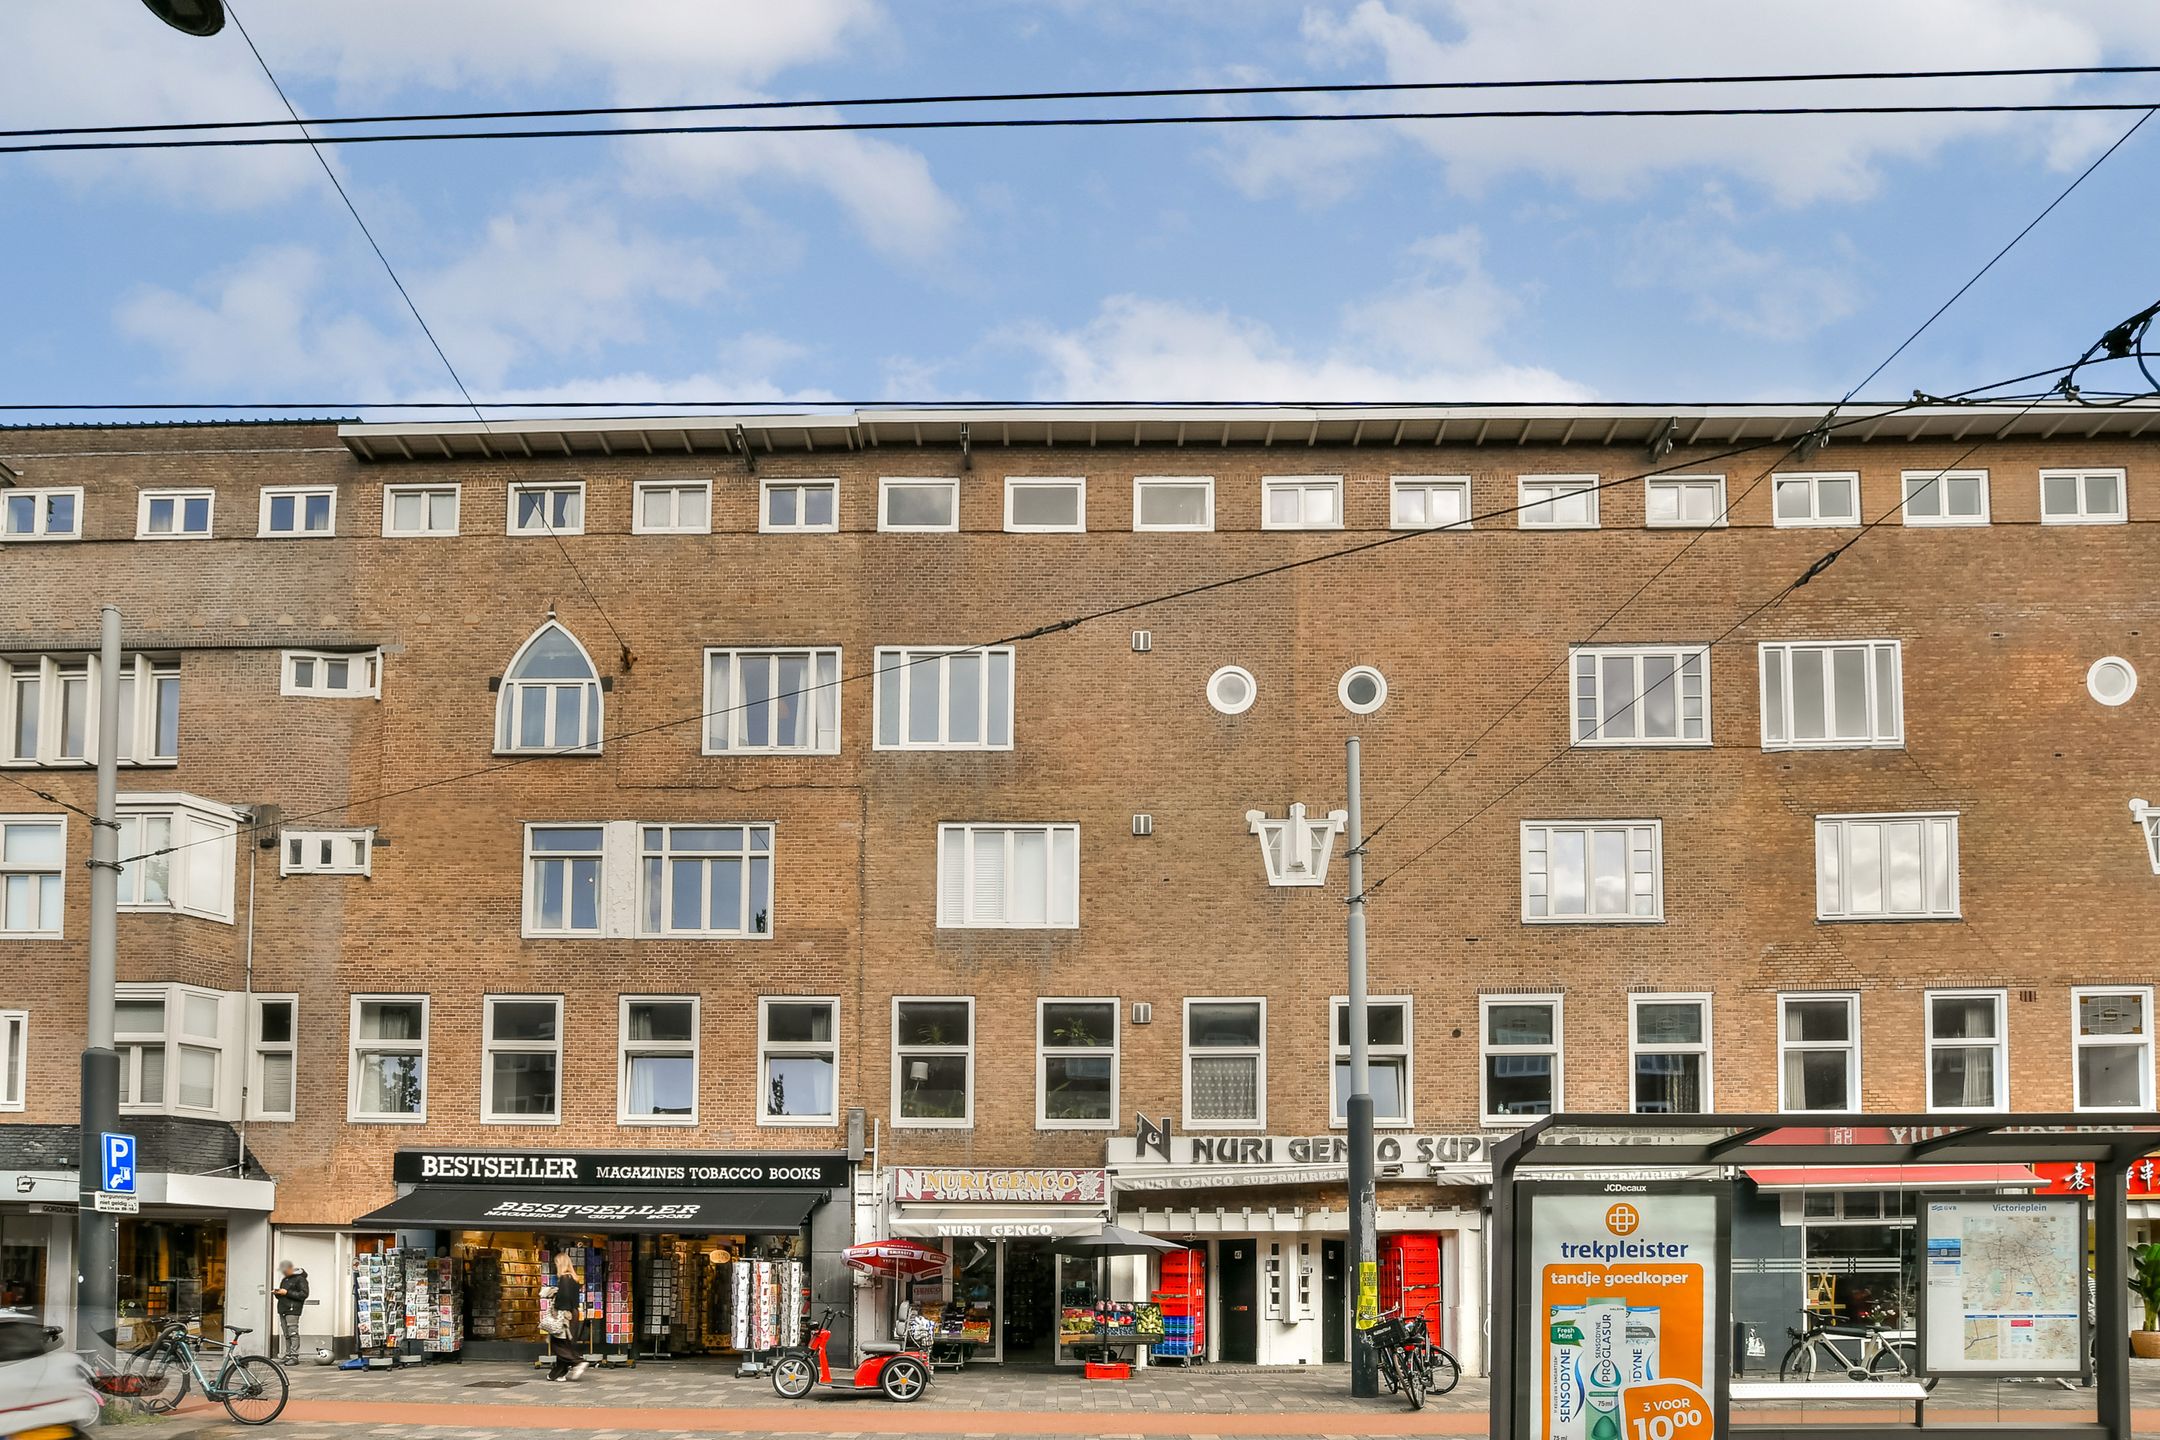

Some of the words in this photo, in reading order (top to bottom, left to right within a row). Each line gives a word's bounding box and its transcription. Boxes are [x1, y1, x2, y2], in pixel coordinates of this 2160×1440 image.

[1147, 1132, 1160, 1145] G
[110, 1138, 129, 1168] P
[1192, 1137, 1273, 1163] NURI
[1288, 1136, 1401, 1162] GENO
[422, 1155, 578, 1179] BESTSELLER
[595, 1165, 685, 1180] MAGAZINES
[689, 1167, 763, 1180] TOBACCO
[769, 1167, 821, 1180] BOOKS
[924, 1171, 988, 1191] NURI
[990, 1170, 1077, 1192] GENCO
[1133, 1179, 1172, 1190] NURI
[1179, 1176, 1234, 1188] GENCO
[1243, 1170, 1347, 1185] SUPERMARKET
[1583, 1170, 1689, 1181] SUPERMARKET
[1604, 1183, 1647, 1192] JCDecaux
[484, 1210, 567, 1219] MAGAZINES
[491, 1201, 701, 1216] BESTSELLER
[1992, 1203, 2047, 1213] Victorieplein
[937, 1224, 982, 1237] NURI
[991, 1224, 1053, 1236] GENCO
[1561, 1238, 1689, 1263] trekpleister
[1551, 1272, 1600, 1287] tandje
[1604, 1272, 1689, 1287] goedkoper
[1602, 1313, 1612, 1382] PROGLASUR
[1560, 1348, 1571, 1423] SENSODYNE
[1643, 1402, 1651, 1412] 3
[1653, 1397, 1691, 1411] VOOR
